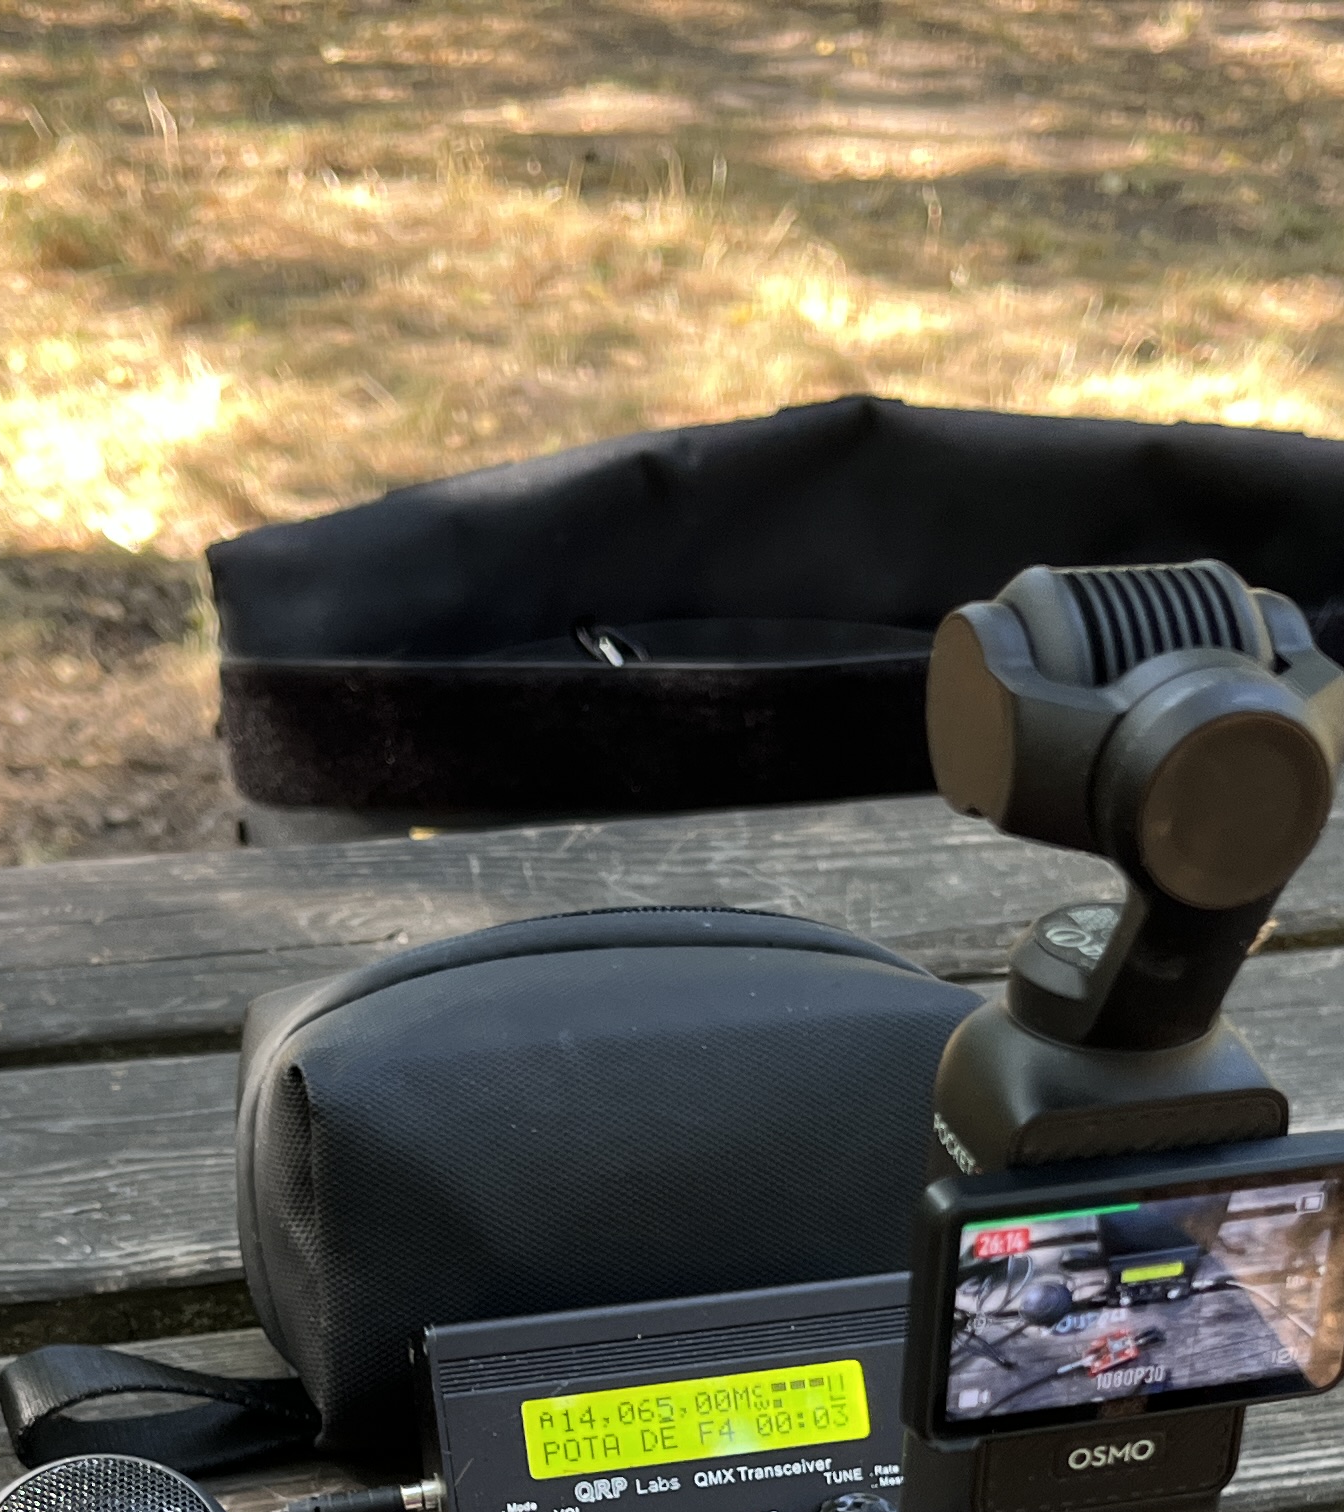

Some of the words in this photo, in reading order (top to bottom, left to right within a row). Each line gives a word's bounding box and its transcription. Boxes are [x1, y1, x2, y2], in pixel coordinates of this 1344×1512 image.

[543, 1433, 621, 1466] POTA
[641, 1425, 679, 1453] DE
[698, 1417, 736, 1445] F4
[756, 1403, 850, 1437] 00:03
[1067, 1439, 1156, 1470] OSMO
[574, 1476, 628, 1503] QRP
[635, 1476, 681, 1495] Labs
[694, 1468, 736, 1488] QMX
[736, 1458, 833, 1482] Transceiver
[823, 1467, 864, 1486] TUNE
